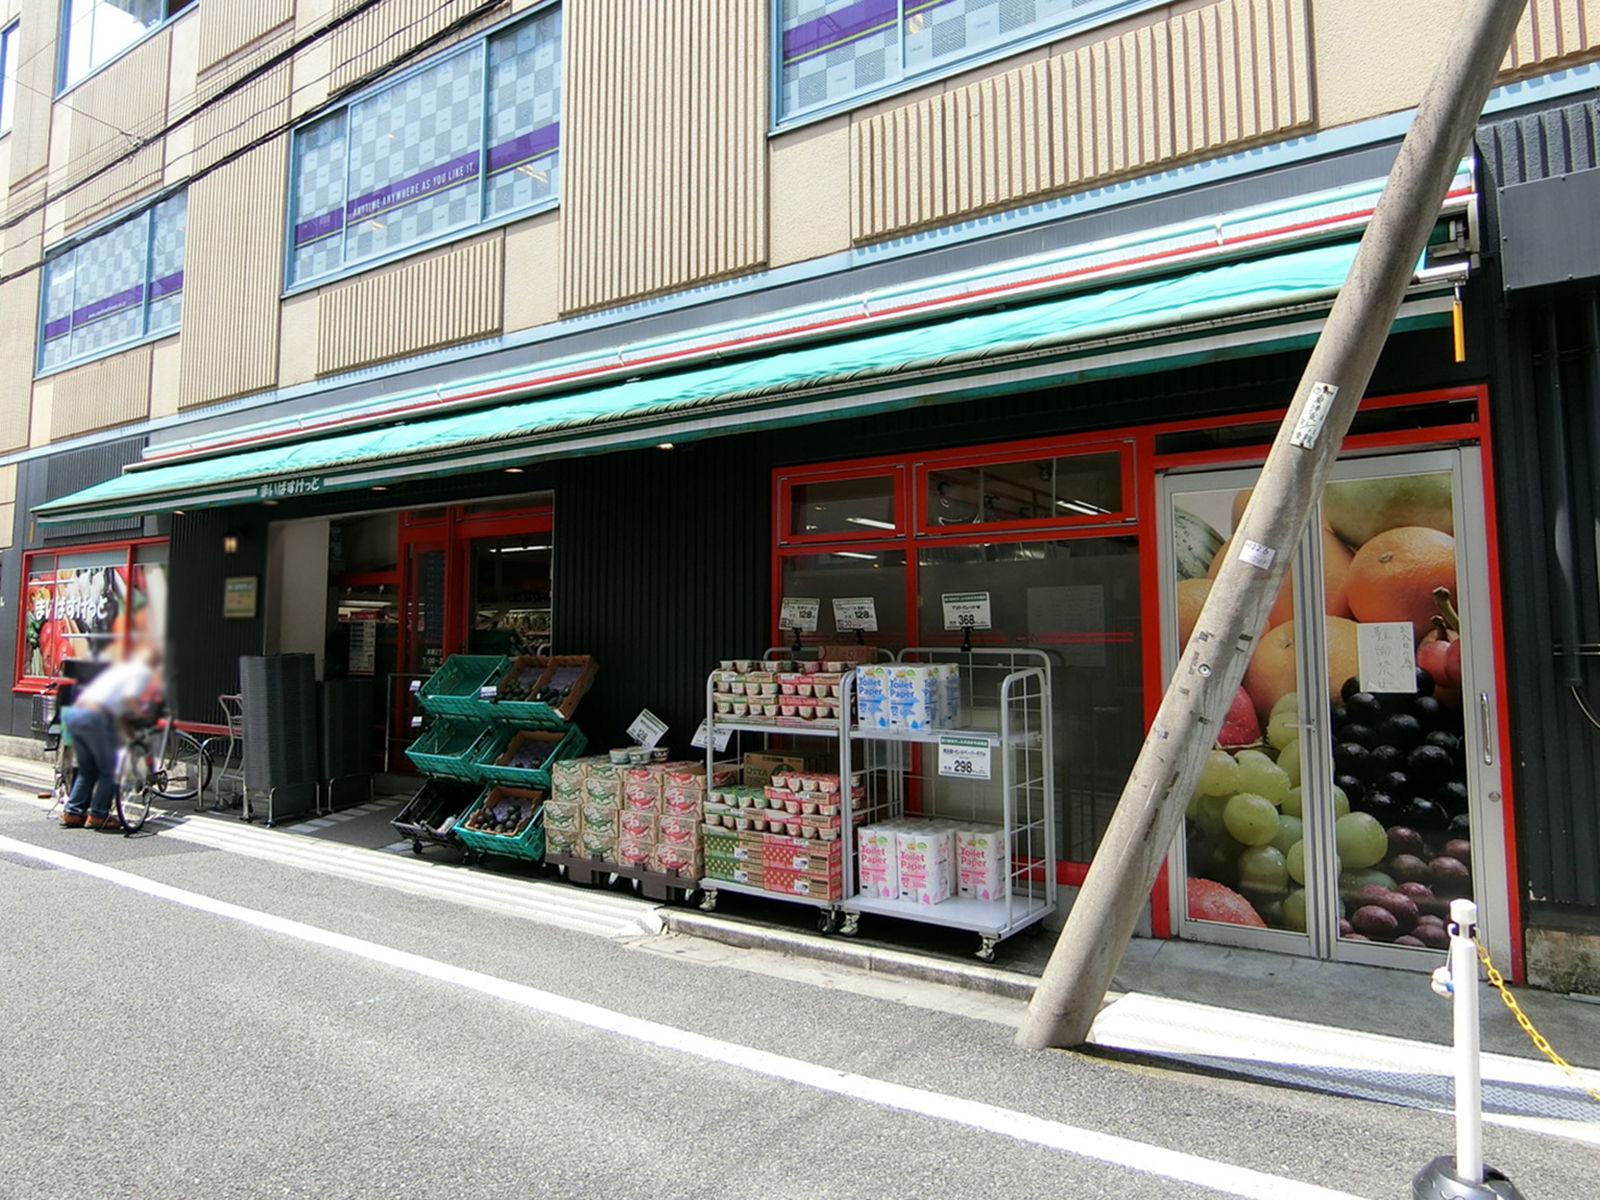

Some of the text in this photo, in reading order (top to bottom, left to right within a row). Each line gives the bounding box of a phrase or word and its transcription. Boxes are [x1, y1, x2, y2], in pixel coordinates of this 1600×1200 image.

[353, 199, 380, 216] ANYTIME
[382, 183, 419, 206] ANYWHERE
[421, 179, 431, 190] AS
[433, 173, 447, 187] YOU
[448, 165, 464, 180] LIKE
[261, 477, 320, 498] まいばすけっと
[799, 610, 813, 619] 128
[854, 610, 870, 619] 128
[958, 614, 975, 626] 368
[858, 676, 882, 687] Toilet
[889, 679, 913, 689] Toilet
[859, 686, 883, 696] Paper
[890, 688, 915, 699] Paper
[954, 759, 973, 773] 298
[861, 844, 886, 856] Toilet
[960, 847, 985, 858] Toilet
[861, 854, 888, 865] Paper
[900, 850, 925, 862] Toilet
[961, 856, 987, 867] Paper
[901, 860, 927, 871] Paper
